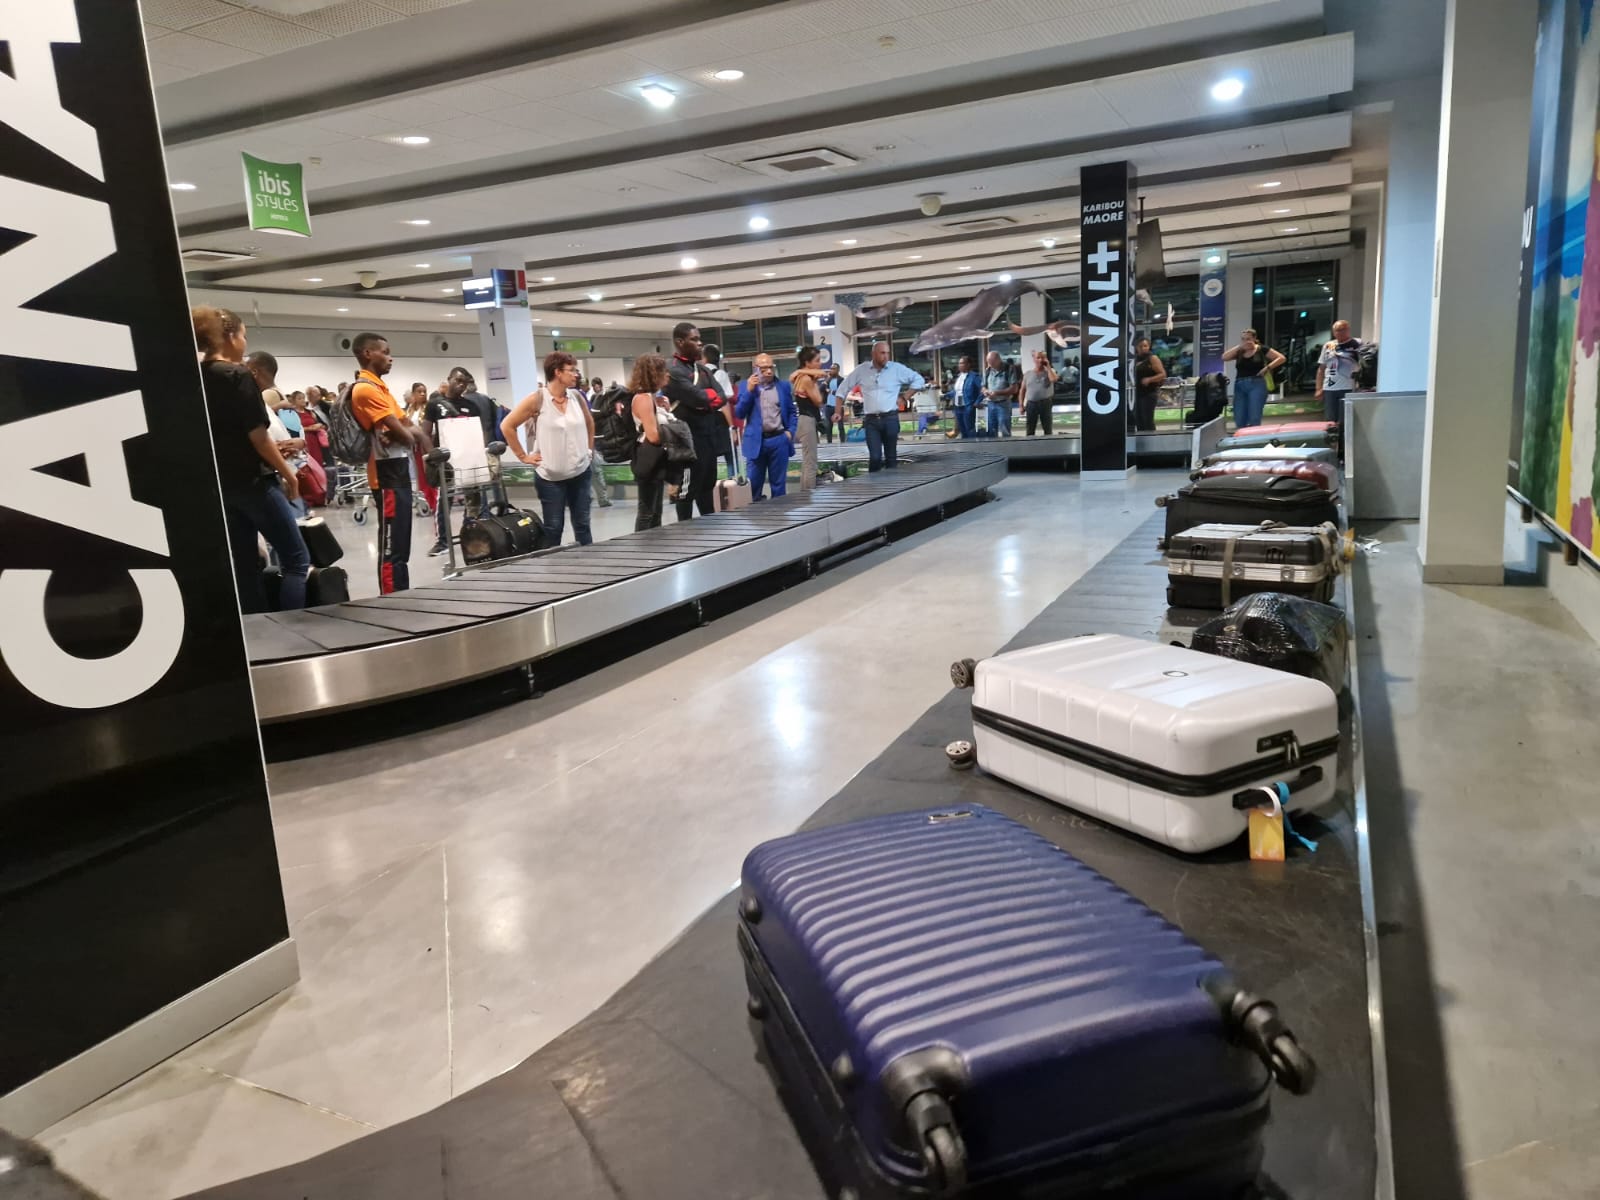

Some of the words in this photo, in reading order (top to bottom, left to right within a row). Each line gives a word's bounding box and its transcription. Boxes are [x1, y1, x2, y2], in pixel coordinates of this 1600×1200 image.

[258, 170, 292, 196] ibis
[1083, 200, 1125, 213] KARIBOU
[1083, 211, 1124, 225] MAORE
[489, 321, 496, 337] 1
[1087, 241, 1120, 415] CANAL+
[820, 336, 826, 345] 2
